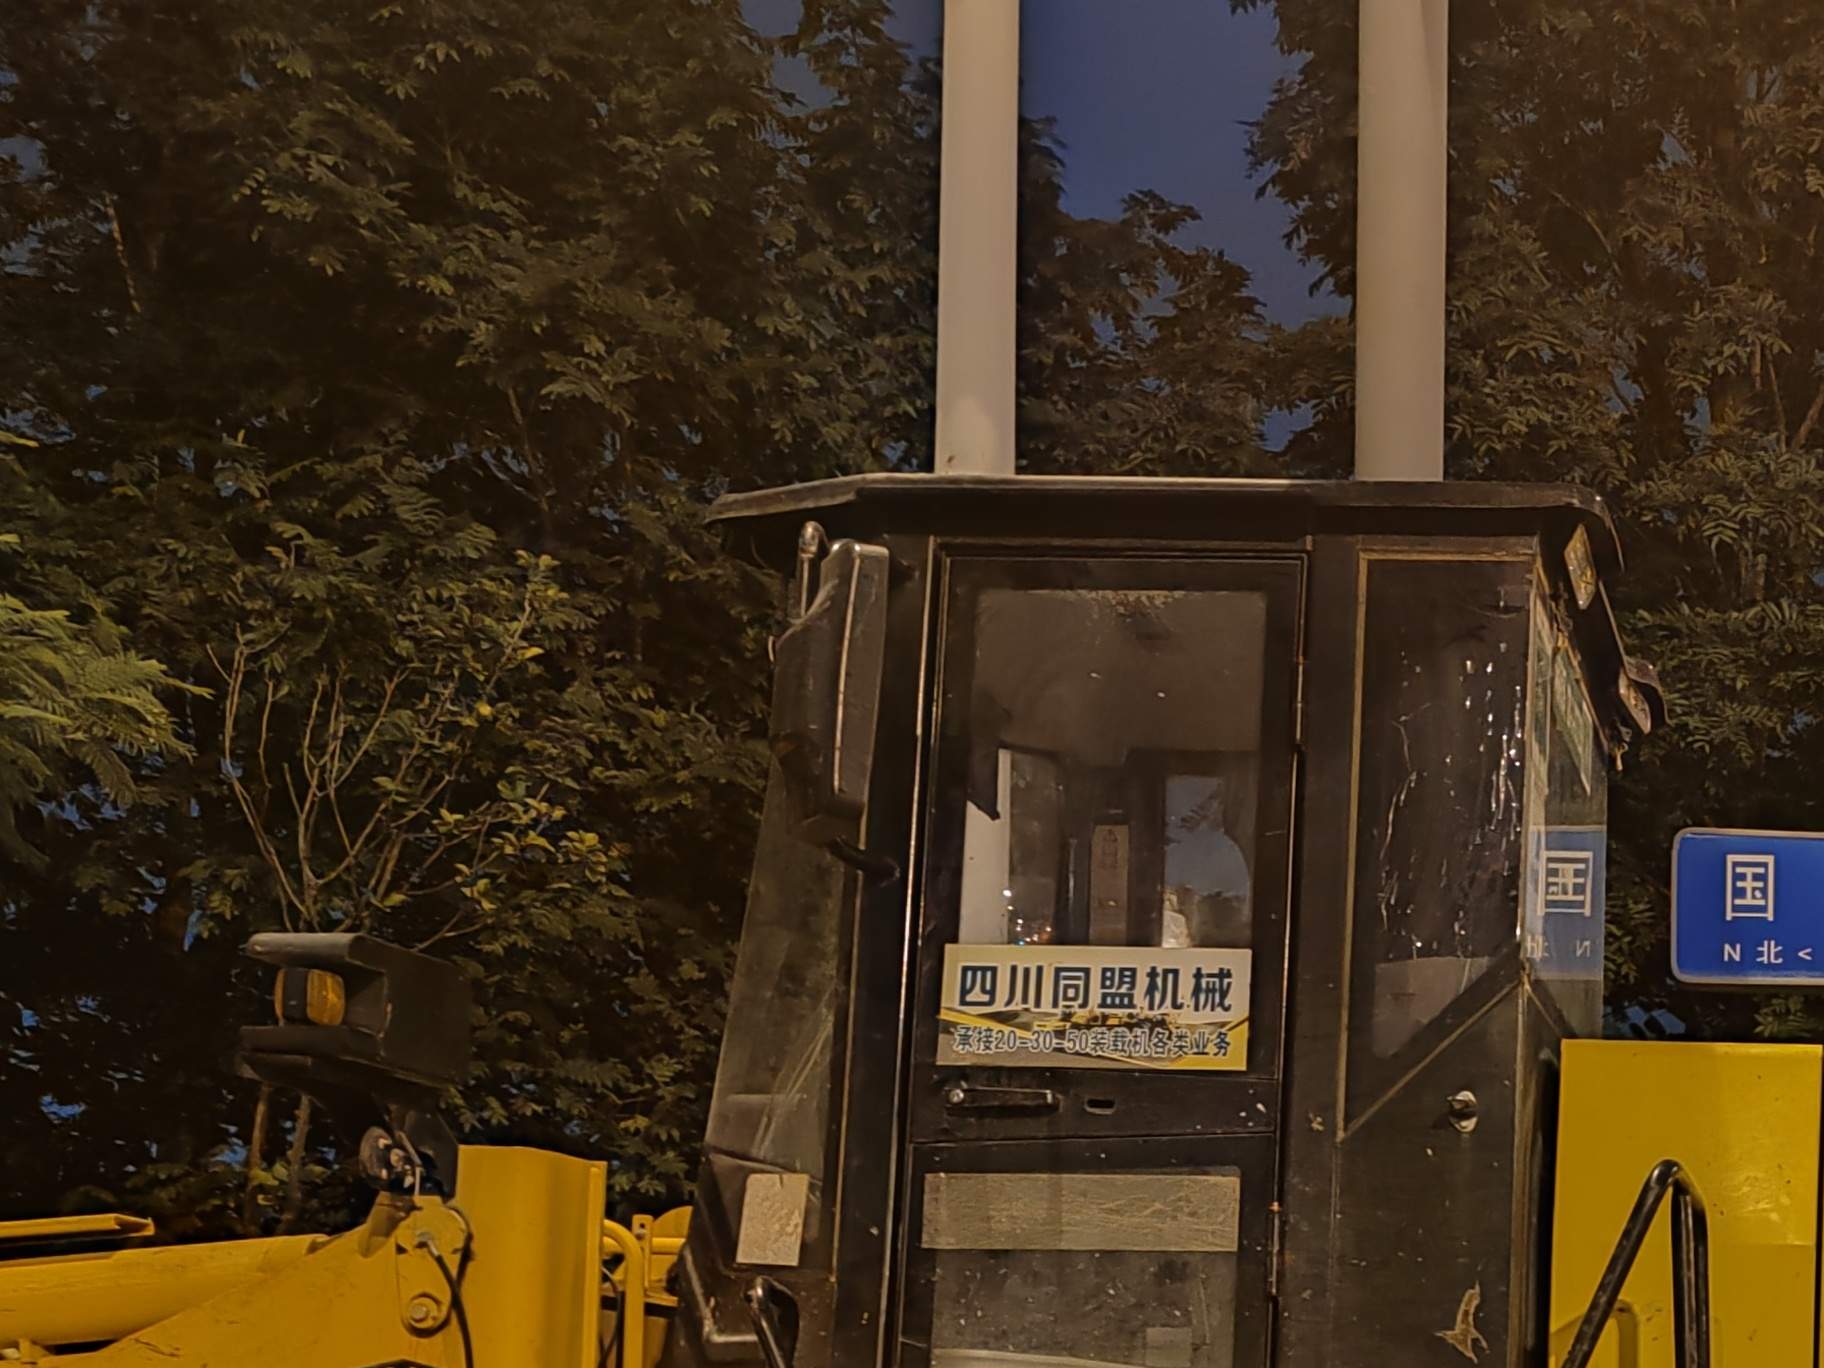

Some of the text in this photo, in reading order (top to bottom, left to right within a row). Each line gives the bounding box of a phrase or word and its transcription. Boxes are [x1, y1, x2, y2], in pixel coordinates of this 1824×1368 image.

[1723, 943, 1741, 962] N
[1755, 940, 1783, 965] 北
[958, 964, 1233, 1012] 四川同盟机械
[953, 1025, 1232, 1058] 承接20-30-50装载机各类业务
